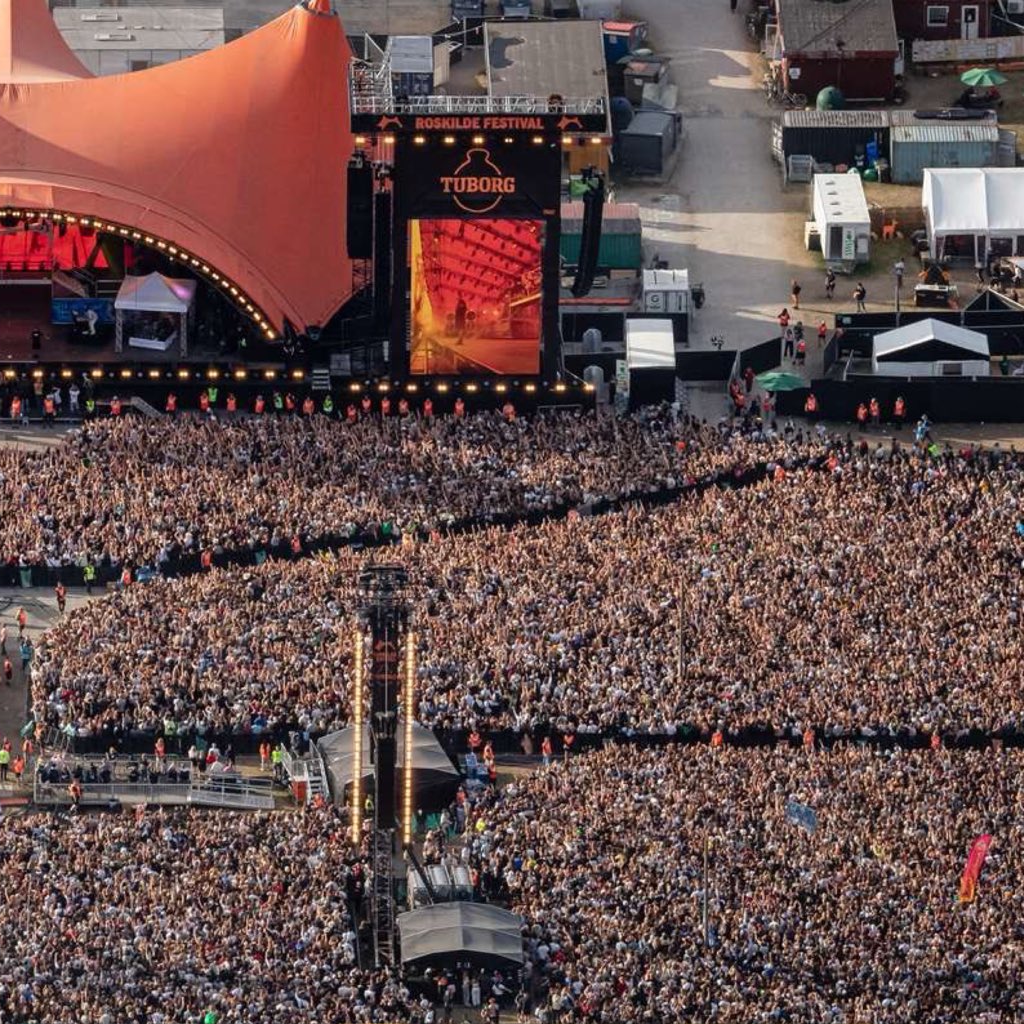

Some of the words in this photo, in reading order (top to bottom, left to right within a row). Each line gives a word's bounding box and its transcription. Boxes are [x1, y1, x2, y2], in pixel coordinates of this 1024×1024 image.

[416, 117, 480, 129] ROSKILDE
[483, 117, 544, 129] FESTIVAL
[440, 177, 515, 193] TUBORG
